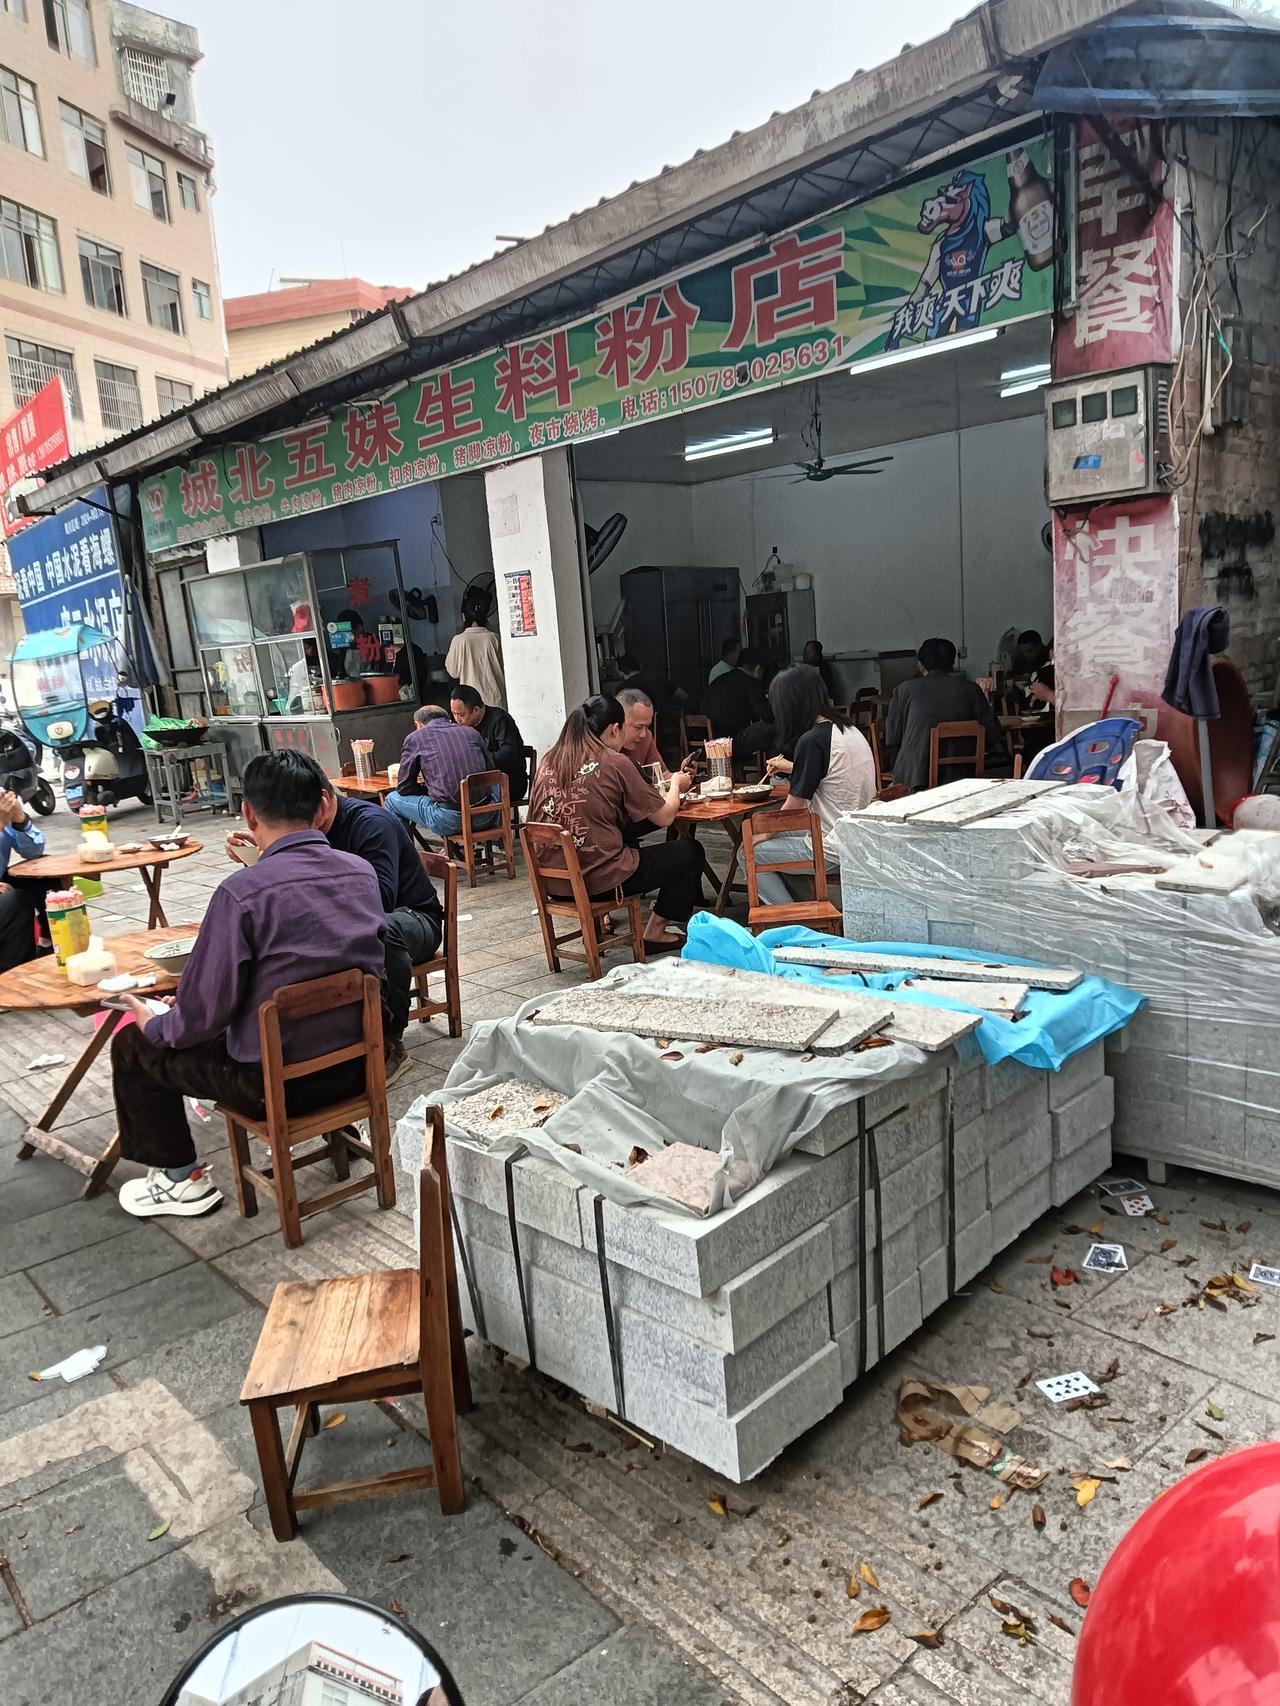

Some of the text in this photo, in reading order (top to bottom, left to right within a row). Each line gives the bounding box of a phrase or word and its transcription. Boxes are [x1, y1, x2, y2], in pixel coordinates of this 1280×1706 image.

[179, 227, 845, 518] 城北五妹生料粉店
